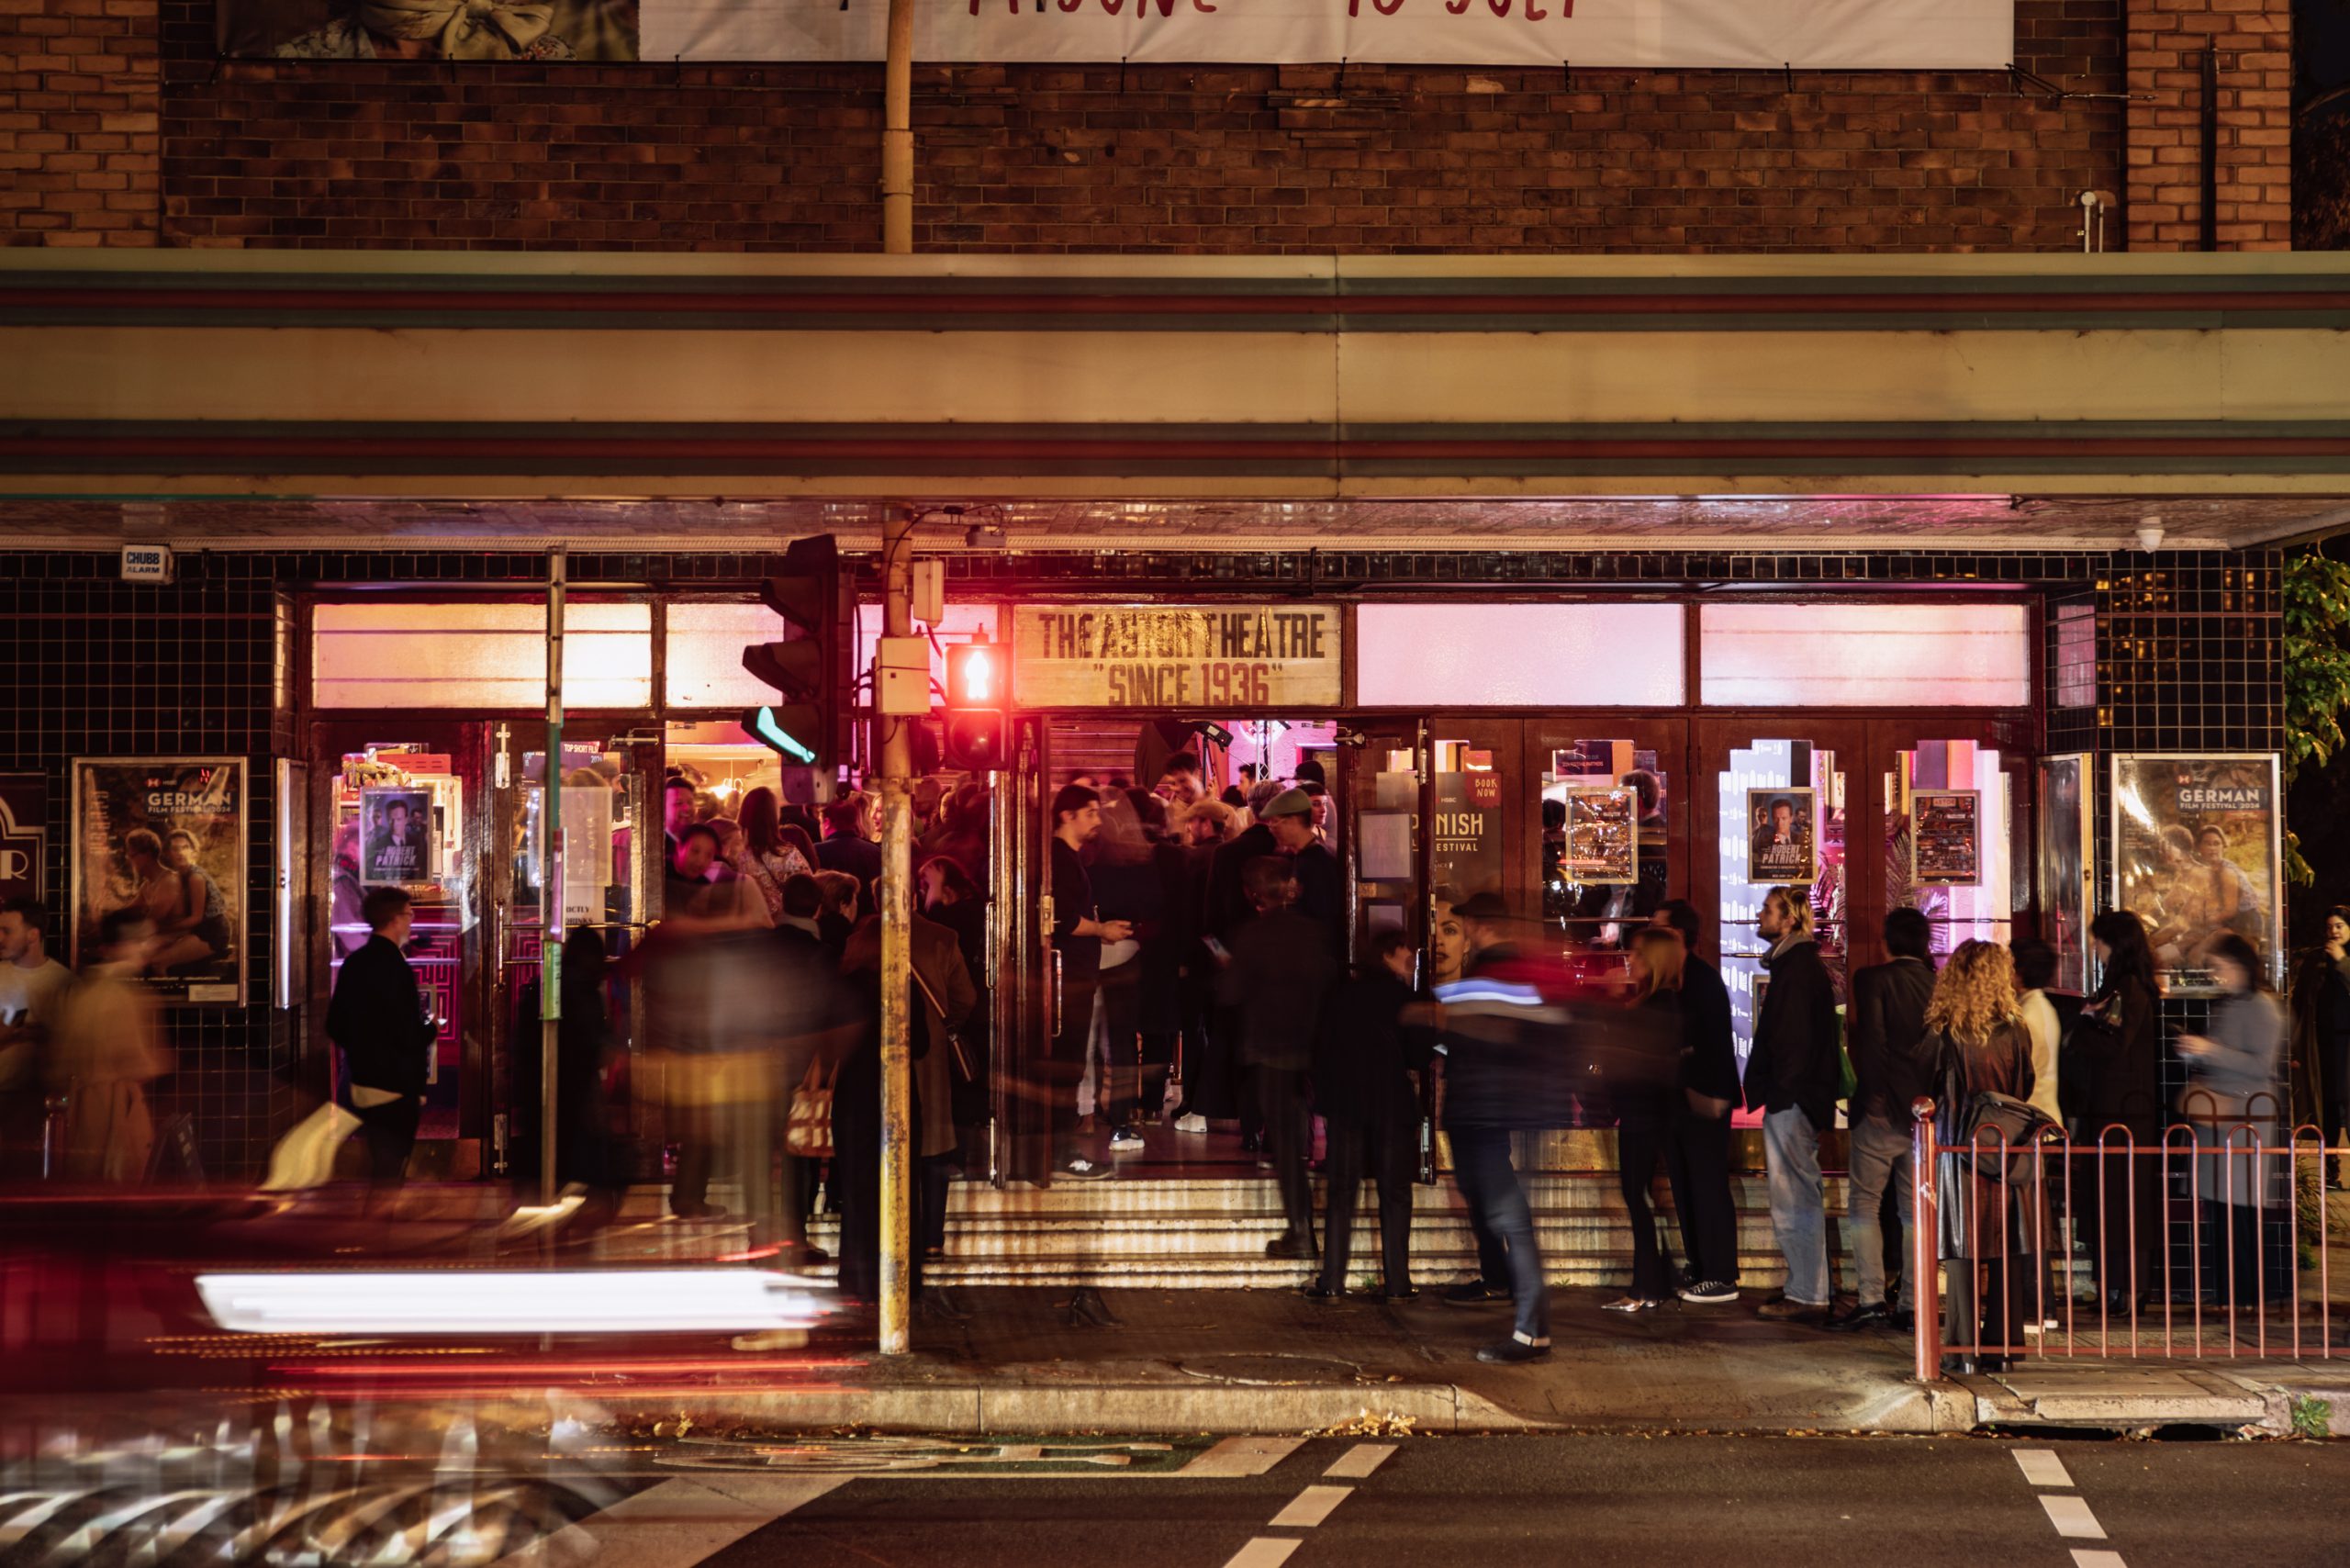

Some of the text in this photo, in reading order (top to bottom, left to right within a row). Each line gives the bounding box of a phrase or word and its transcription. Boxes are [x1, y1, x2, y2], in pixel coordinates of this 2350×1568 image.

[126, 552, 160, 565] CHUBB
[1038, 613, 1093, 658] THE
[1201, 612, 1326, 658] THEATRE
[1475, 778, 1497, 788] BOOK
[1477, 789, 1495, 797] NOW
[2179, 790, 2259, 802] GERMAN
[148, 792, 230, 806] GERMAN
[1436, 843, 1478, 852] ESTIVAL
[1772, 845, 1801, 854] ROBERT
[375, 855, 417, 866] PATRICK
[1762, 854, 1802, 864] PATRICK
